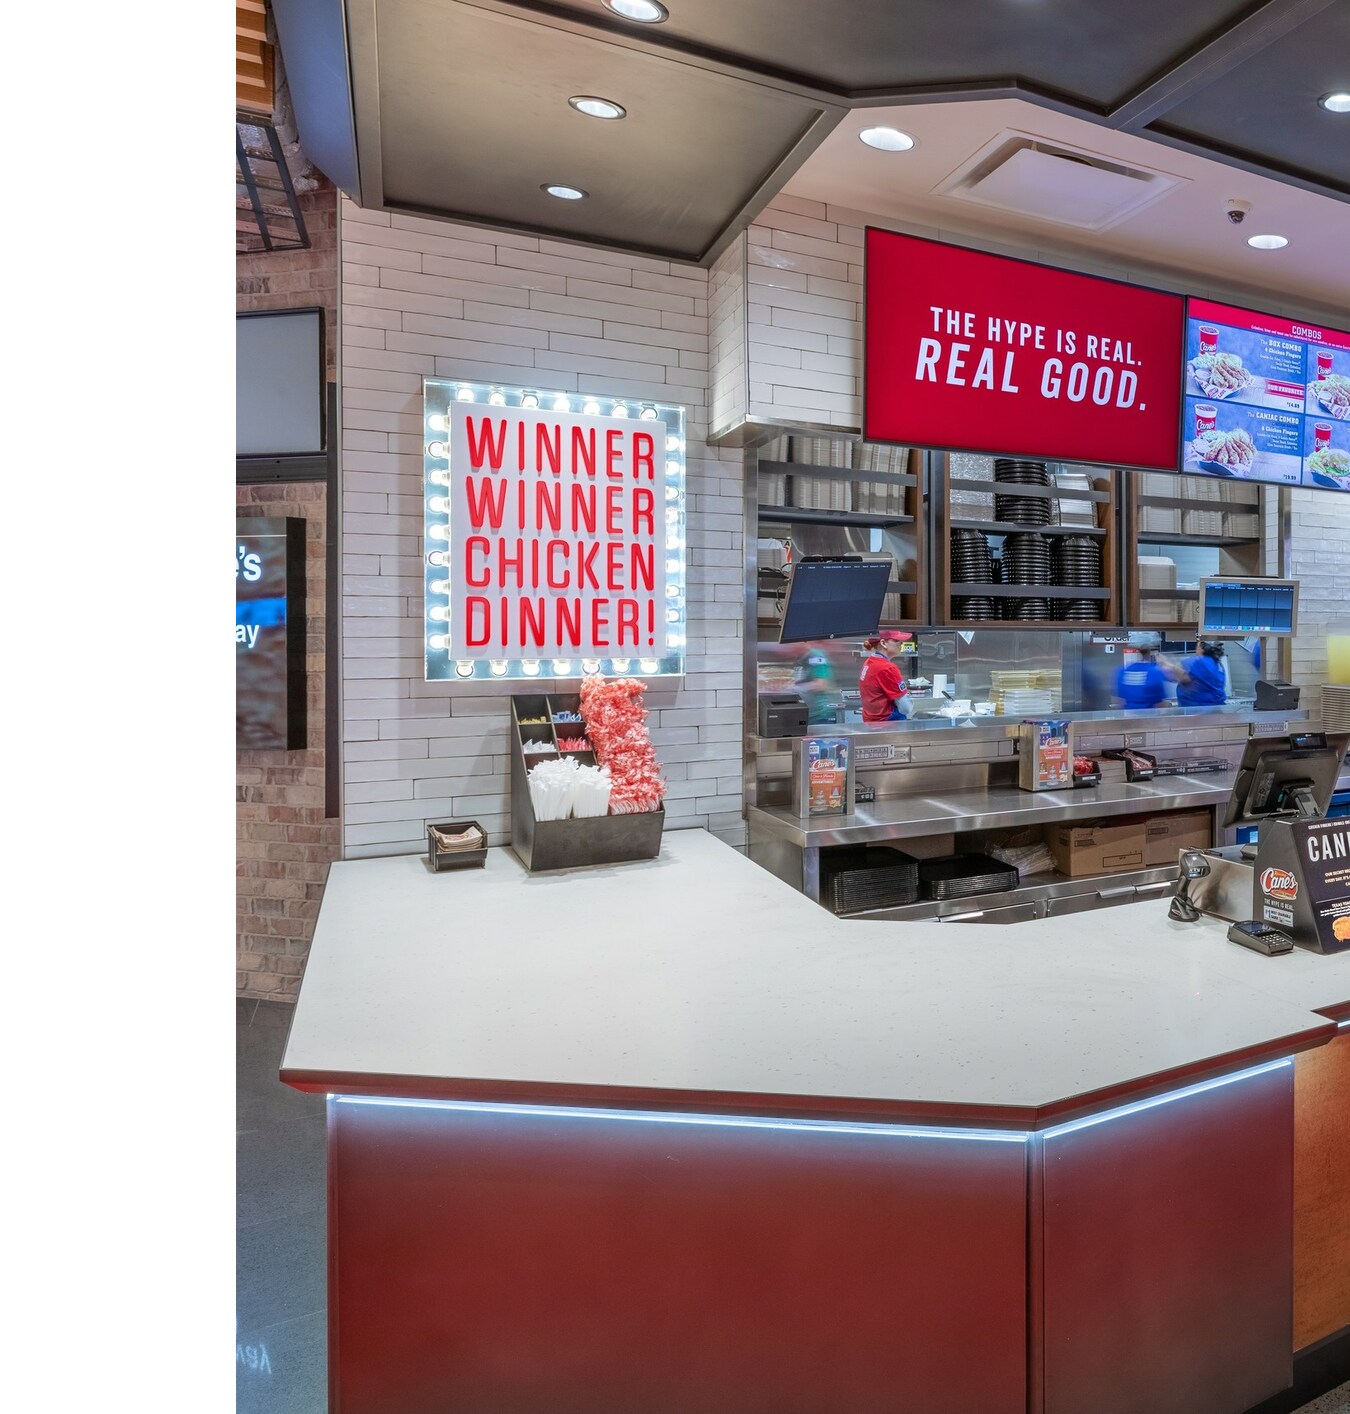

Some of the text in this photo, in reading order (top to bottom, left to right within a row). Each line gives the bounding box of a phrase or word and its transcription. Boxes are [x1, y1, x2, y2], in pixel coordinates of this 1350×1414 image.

[930, 306, 1142, 366] THE HYPE IS REAL.
[1282, 342, 1302, 352] COMBO
[1292, 325, 1322, 340] COMBOS
[915, 337, 1147, 411] REAL GOOD.
[1256, 412, 1278, 421] CANIAC
[1279, 416, 1299, 424] COMBO
[466, 416, 654, 480] WINNER
[466, 476, 654, 535] WINNER
[466, 536, 654, 591] CHICKEN
[466, 596, 654, 646] DINNER!
[1263, 867, 1296, 893] Cane's
